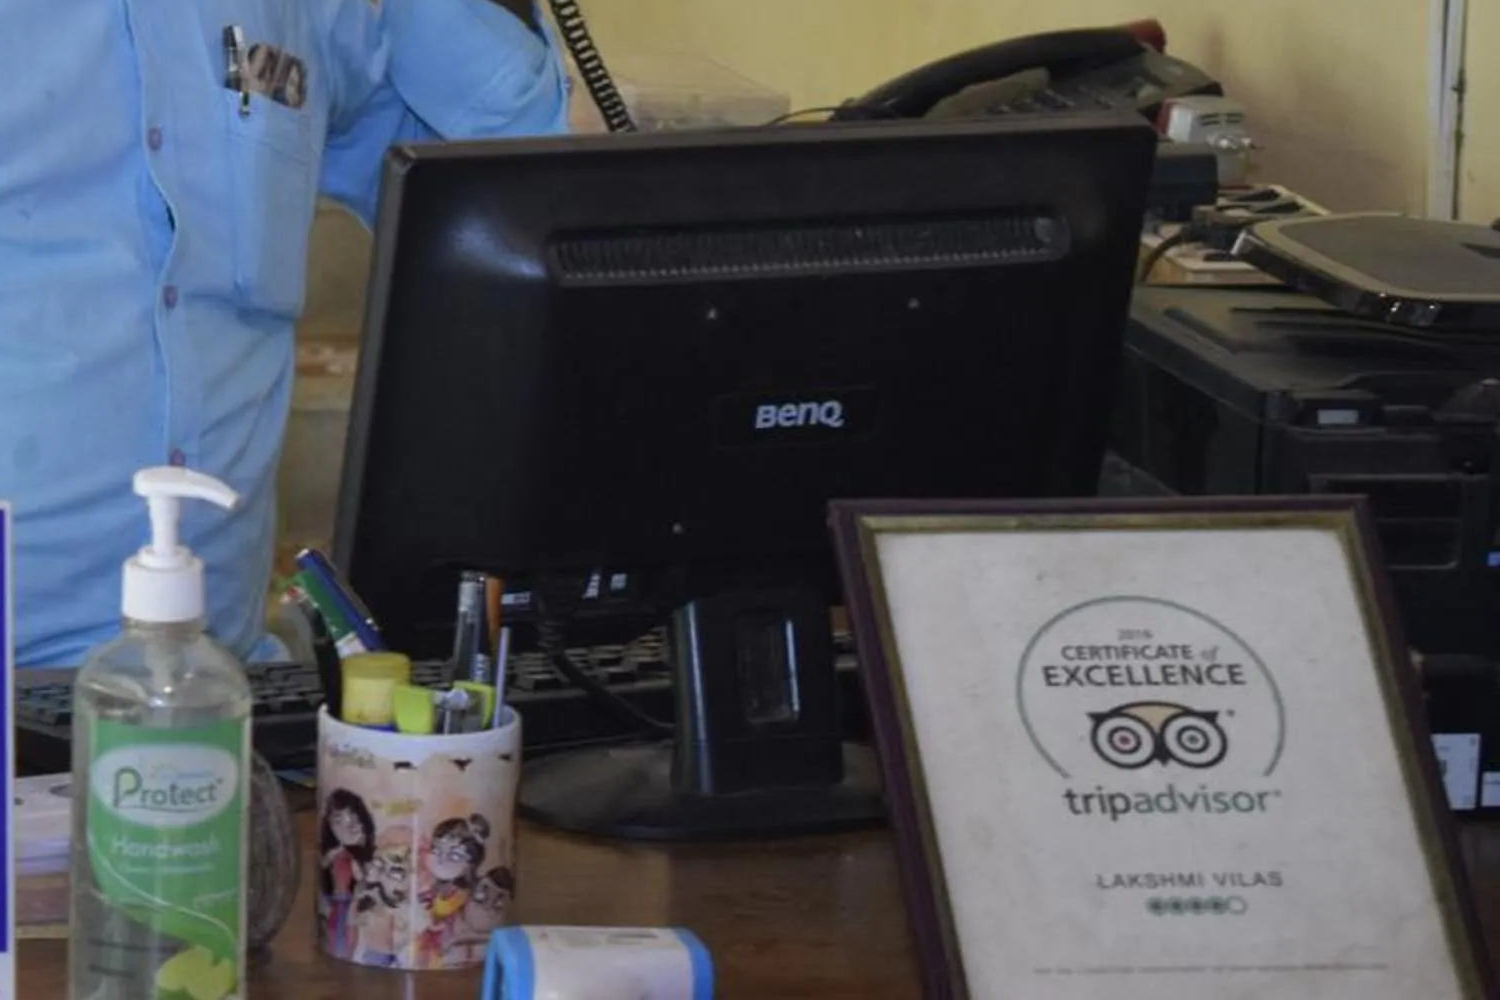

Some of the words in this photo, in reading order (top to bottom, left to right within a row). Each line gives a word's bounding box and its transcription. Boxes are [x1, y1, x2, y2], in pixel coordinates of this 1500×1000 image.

[755, 400, 845, 429] BenQ
[1061, 645, 1193, 661] CERTIFICATE
[1042, 663, 1248, 687] EXCELLENCE
[113, 767, 217, 808] Protect
[1063, 784, 1270, 822] tripadvisor
[1097, 871, 1204, 889] LAKSHMI
[1213, 871, 1284, 888] VILAS
